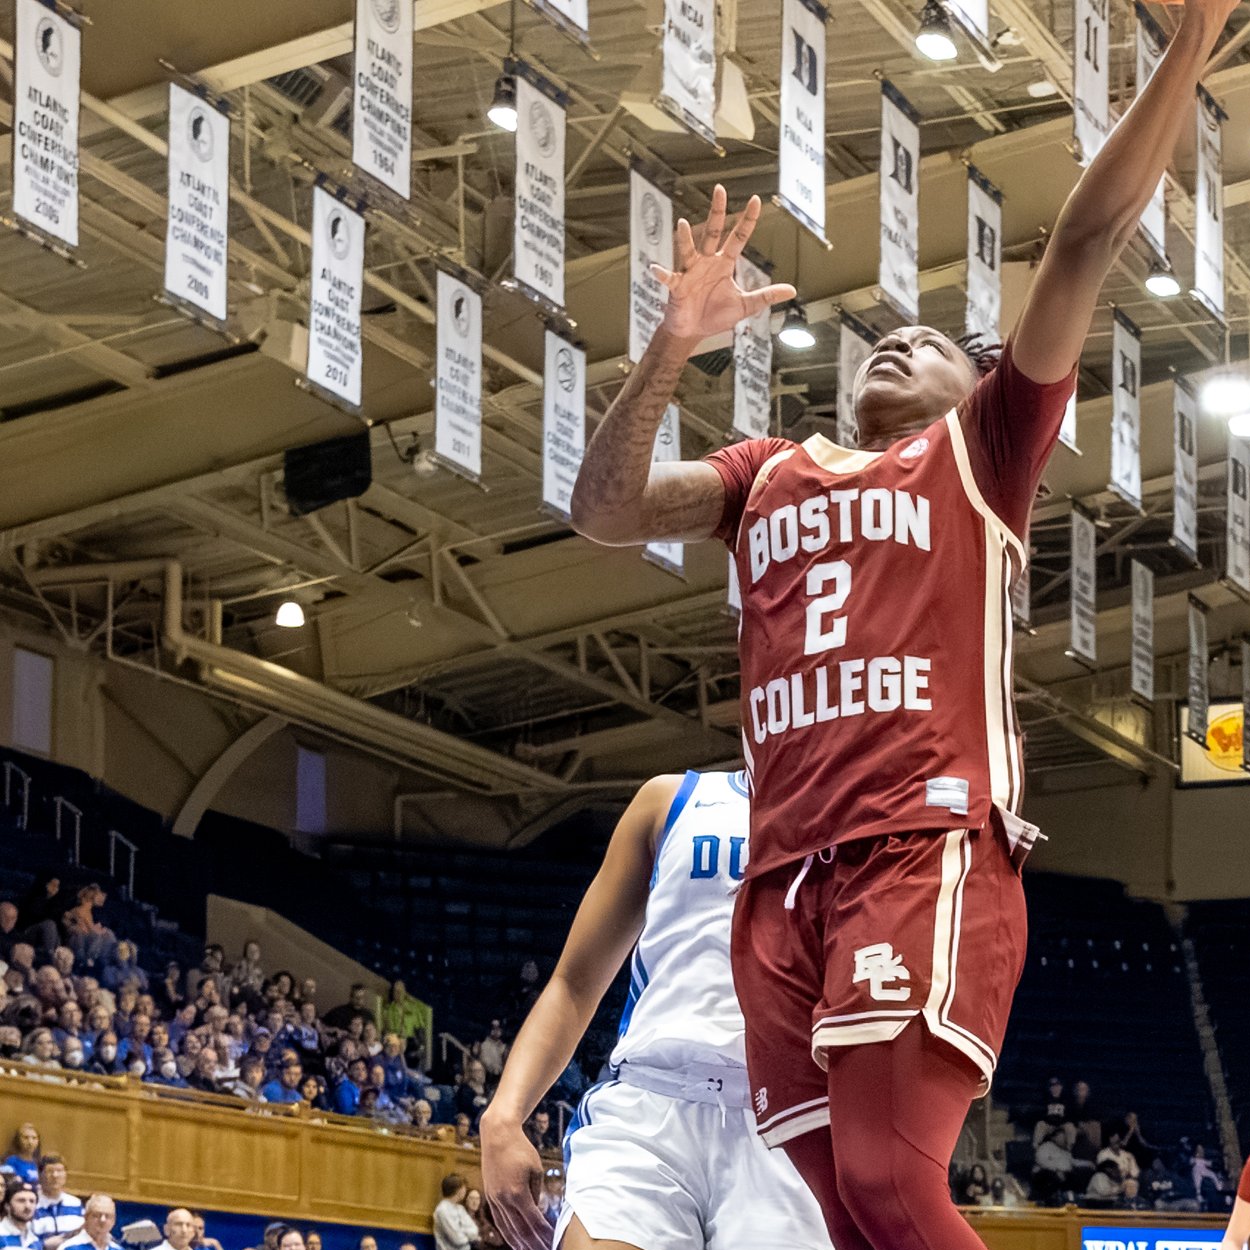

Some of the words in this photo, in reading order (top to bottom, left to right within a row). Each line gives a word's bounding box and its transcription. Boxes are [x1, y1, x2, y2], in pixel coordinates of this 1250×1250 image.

[19, 121, 78, 169] CONFERENCE
[749, 488, 932, 584] BOSTON
[803, 559, 852, 656] 2
[750, 655, 933, 745] COLLEGE
[690, 835, 746, 880] DU
